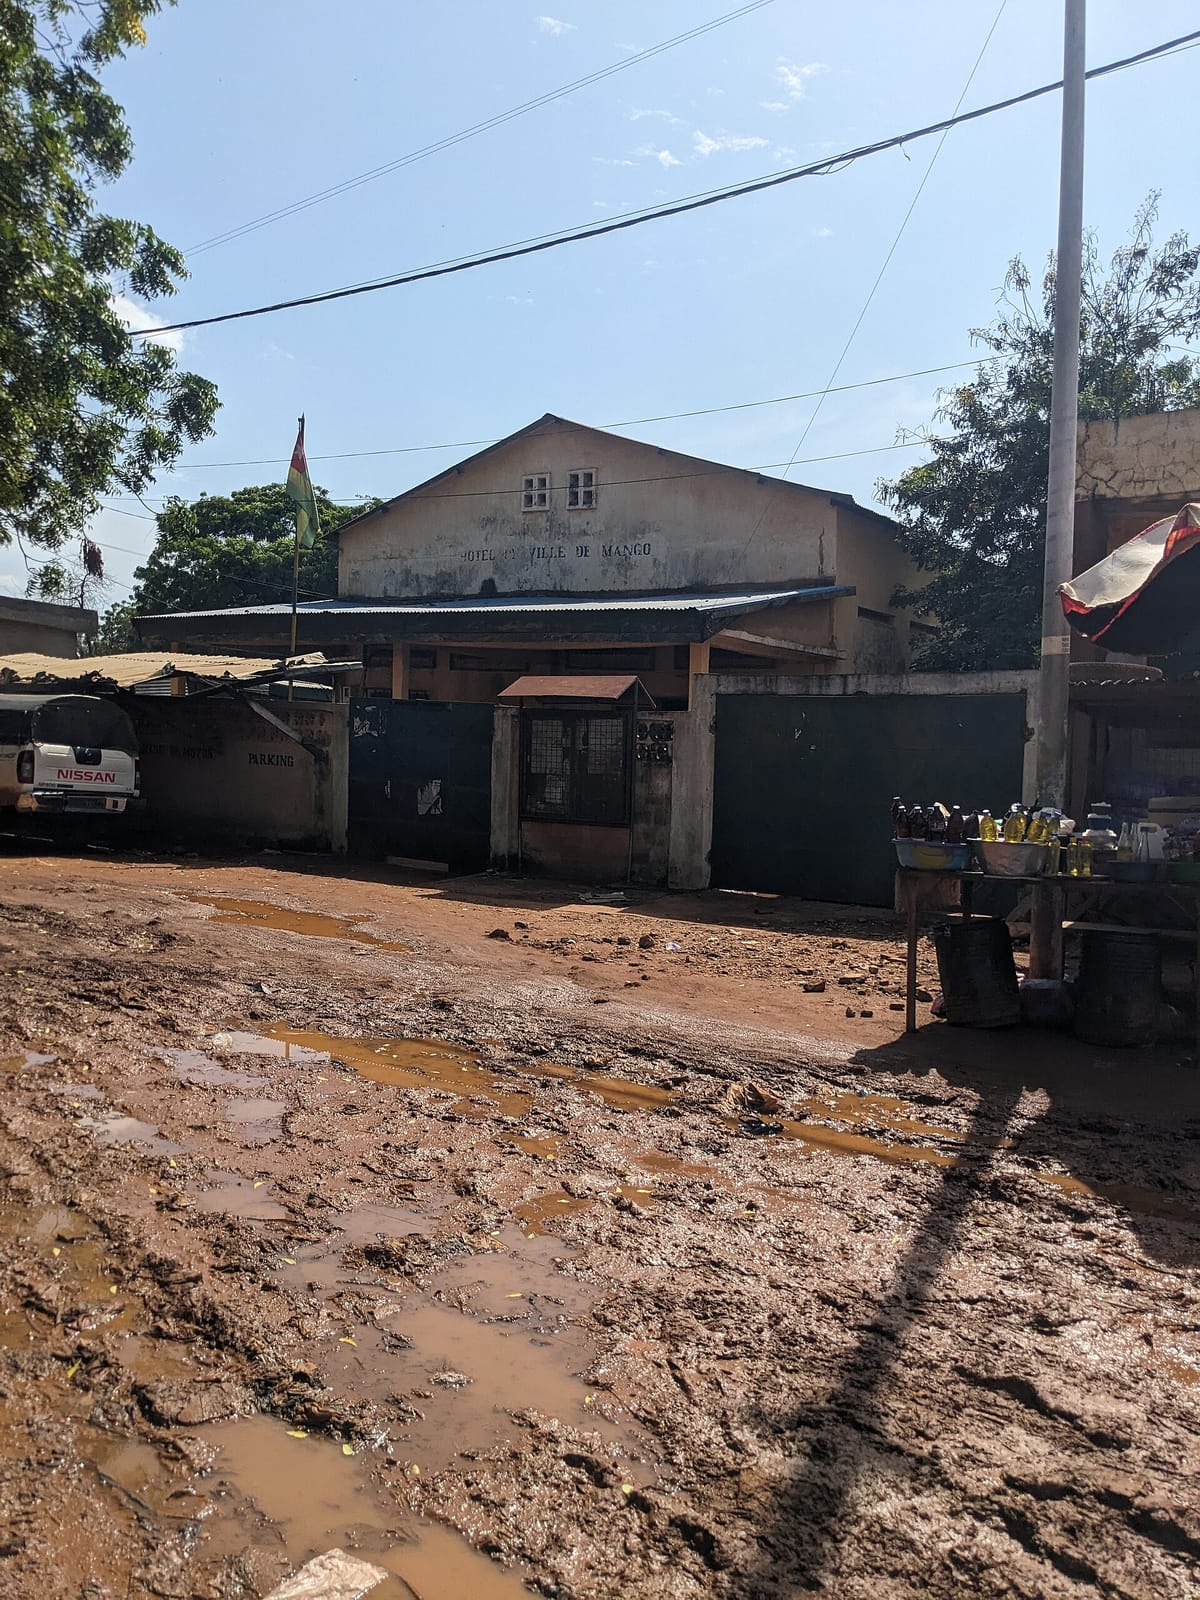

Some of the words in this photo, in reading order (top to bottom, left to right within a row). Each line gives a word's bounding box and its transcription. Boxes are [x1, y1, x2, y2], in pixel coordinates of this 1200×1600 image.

[529, 546, 566, 559] VILLE
[575, 545, 591, 558] DE
[602, 543, 651, 557] MANGO
[248, 753, 294, 767] PARKING
[57, 769, 116, 783] NISSAN
